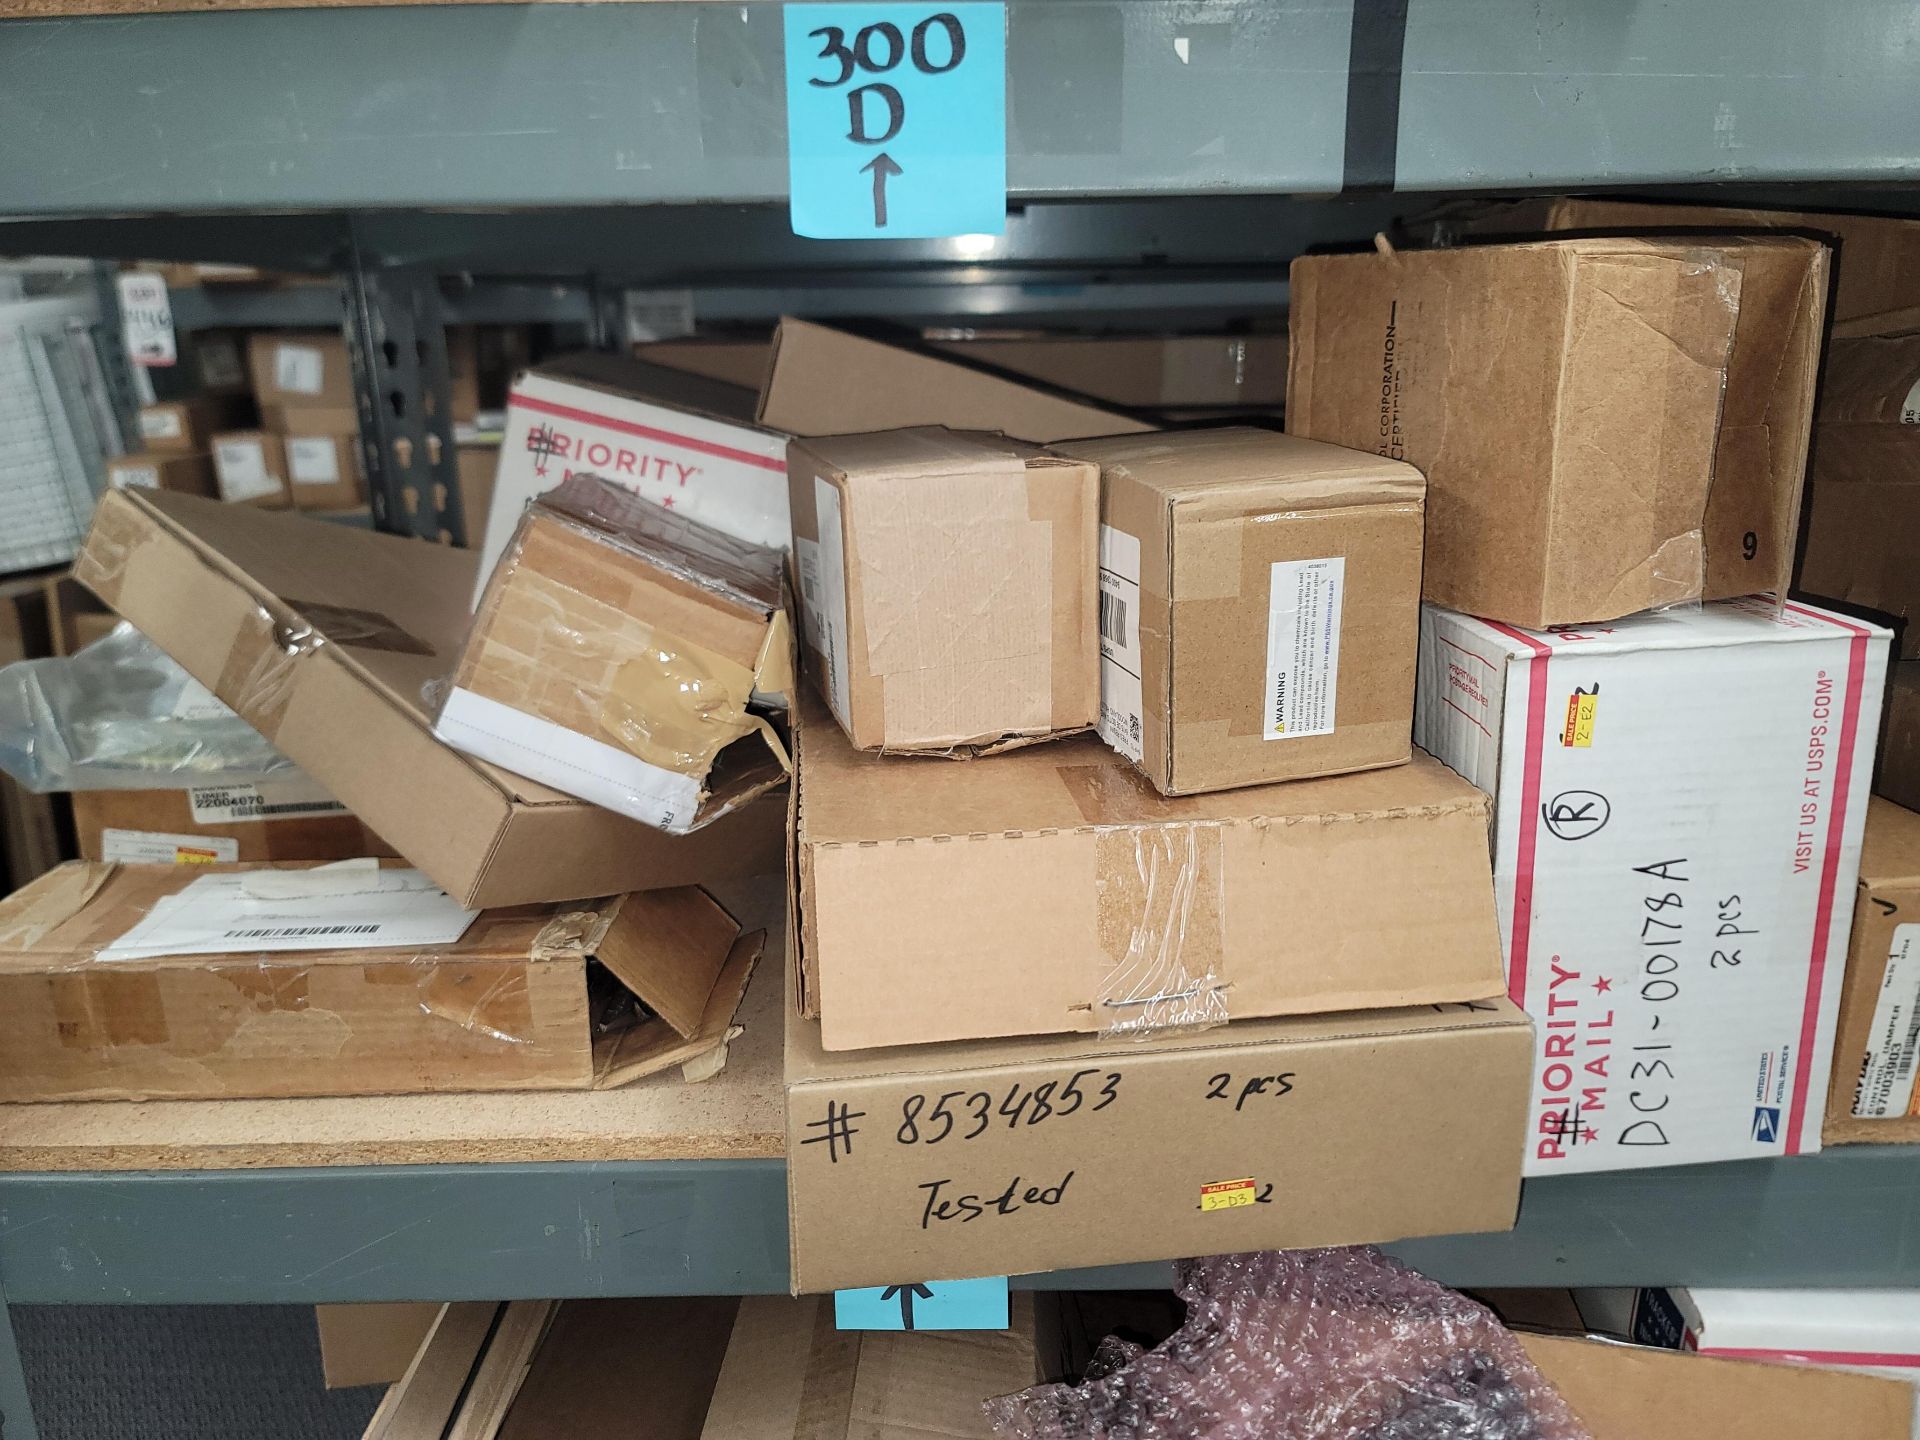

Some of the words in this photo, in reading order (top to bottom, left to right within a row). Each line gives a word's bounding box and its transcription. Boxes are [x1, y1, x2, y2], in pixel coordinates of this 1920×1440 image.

[807, 12, 966, 87] 300
[846, 82, 905, 145] D
[1380, 325, 1396, 437] CORPORATION
[1743, 531, 1758, 561] 9
[1275, 671, 1285, 723] WARNING
[1569, 703, 1577, 723] PRICE
[1567, 723, 1575, 741] SALE
[1804, 778, 1821, 798] AT
[1800, 803, 1817, 825] US
[1793, 831, 1814, 874] VISIT
[1716, 894, 1760, 936] pcs
[1711, 950, 1741, 968] 2
[1582, 1010, 1614, 1110] MAIL
[1875, 1043, 1902, 1116] 67003903
[896, 1068, 1123, 1146] 8534853
[1205, 1073, 1231, 1100] 2
[1236, 1072, 1296, 1111] pcs
[917, 1170, 1075, 1229] Tested
[1207, 1184, 1225, 1193] SALE
[1226, 1182, 1247, 1190] PRICE
